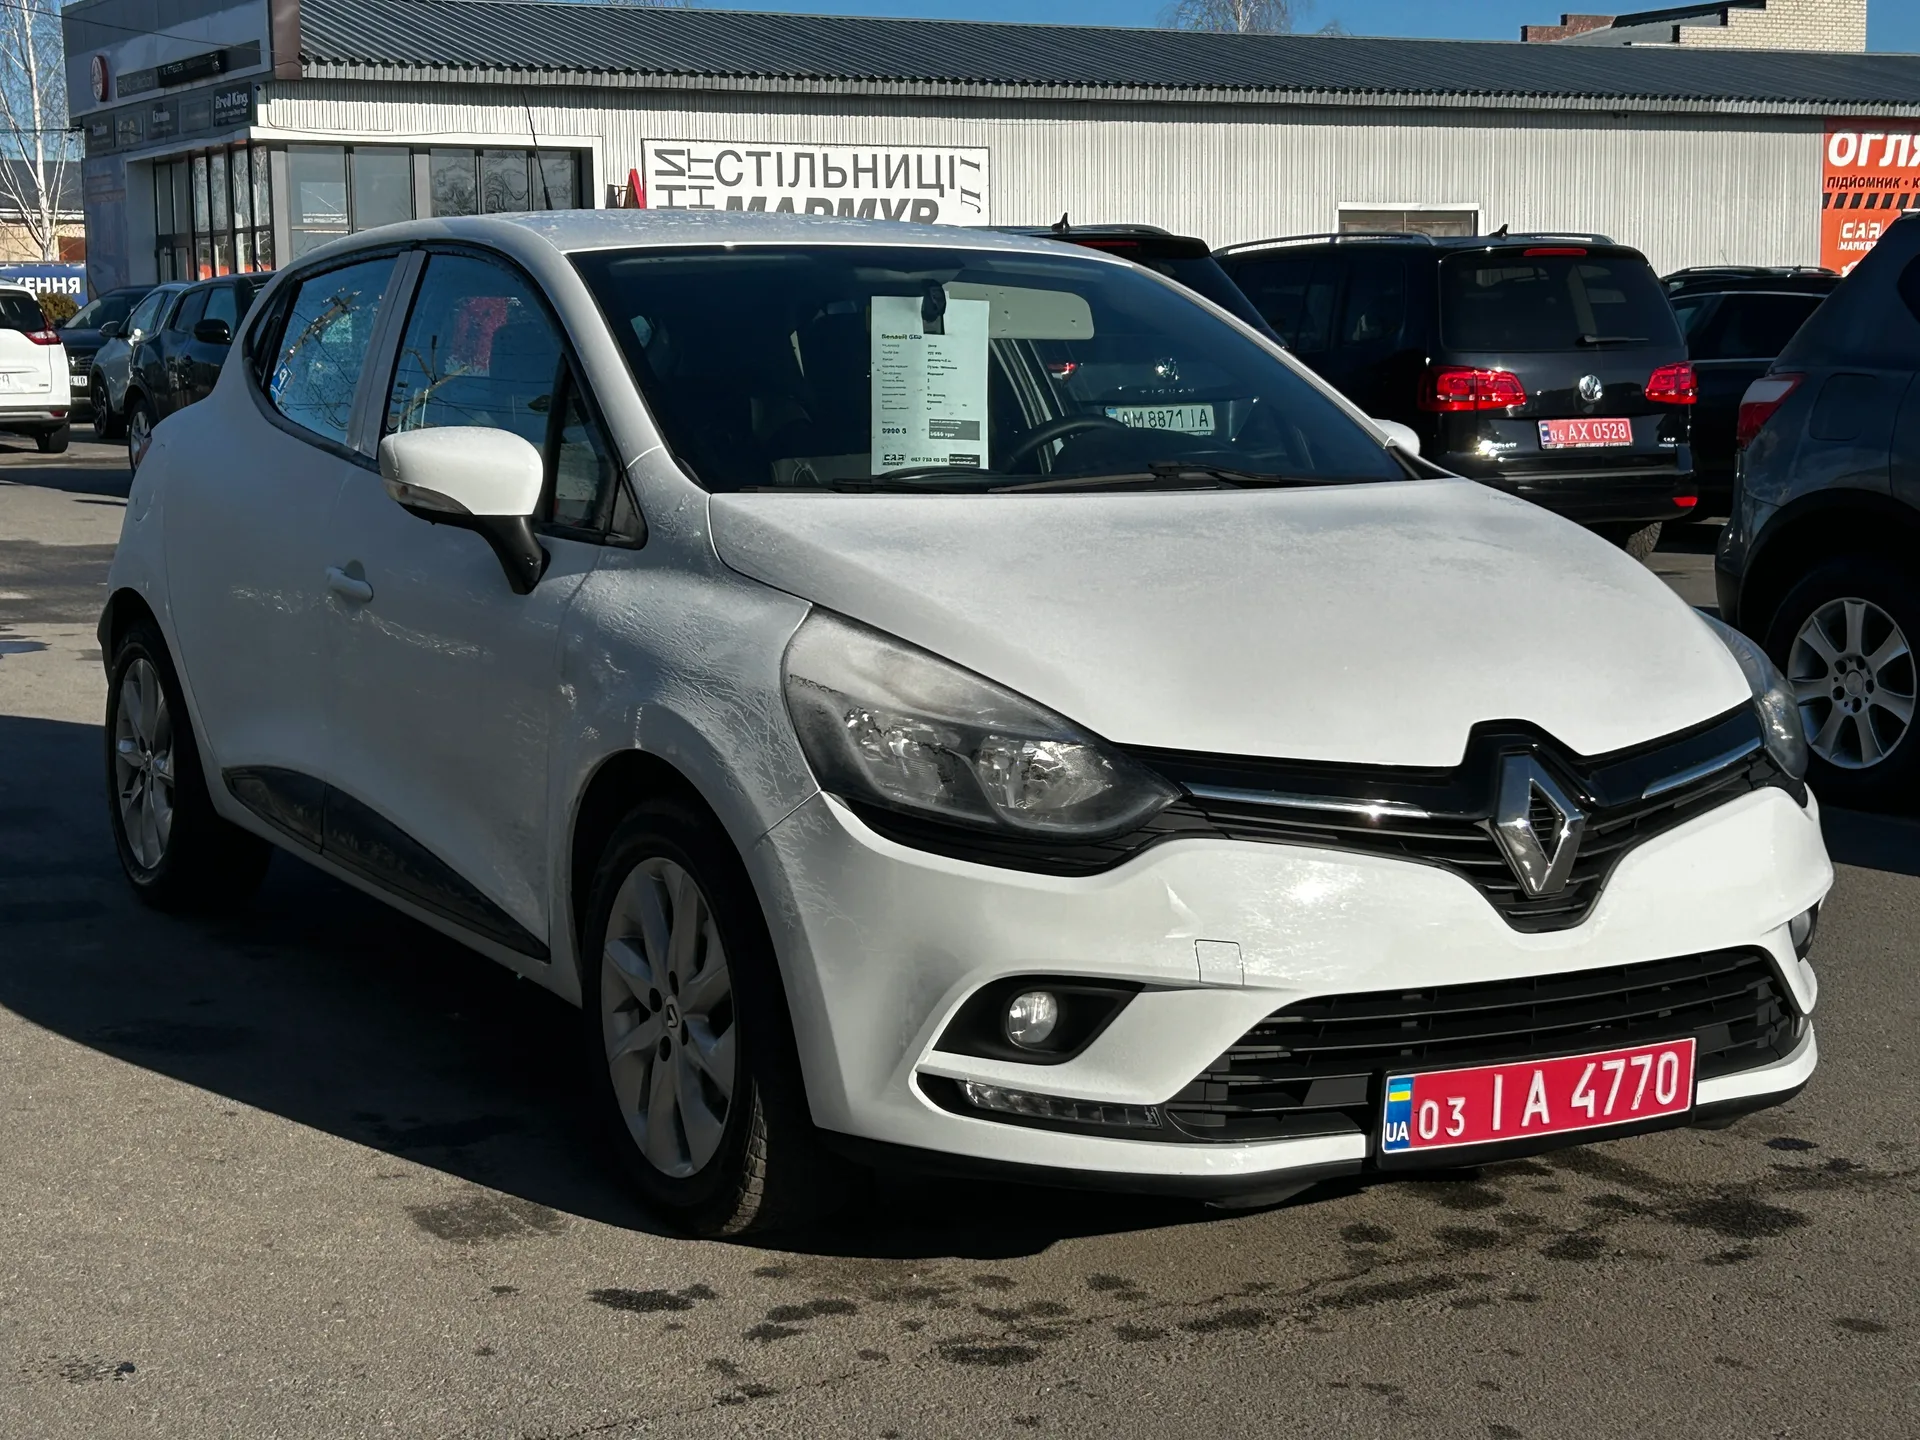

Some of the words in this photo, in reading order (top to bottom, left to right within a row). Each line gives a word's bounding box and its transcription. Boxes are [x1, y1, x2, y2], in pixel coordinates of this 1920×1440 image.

[715, 149, 955, 198] СТІЛЬНИЦІ
[1827, 175, 1901, 189] ПІДЙОМНИК
[1842, 222, 1880, 239] CAR
[17, 277, 80, 294] ЕННЯ
[1148, 409, 1183, 428] 8871
[1190, 409, 1209, 428] IA
[1550, 429, 1565, 442] 06
[1568, 423, 1590, 441] AX
[1592, 422, 1626, 440] 0528
[1385, 1121, 1410, 1143] UA
[1418, 1097, 1466, 1140] 03
[1492, 1070, 1550, 1131] IA
[1571, 1051, 1679, 1118] 4770
